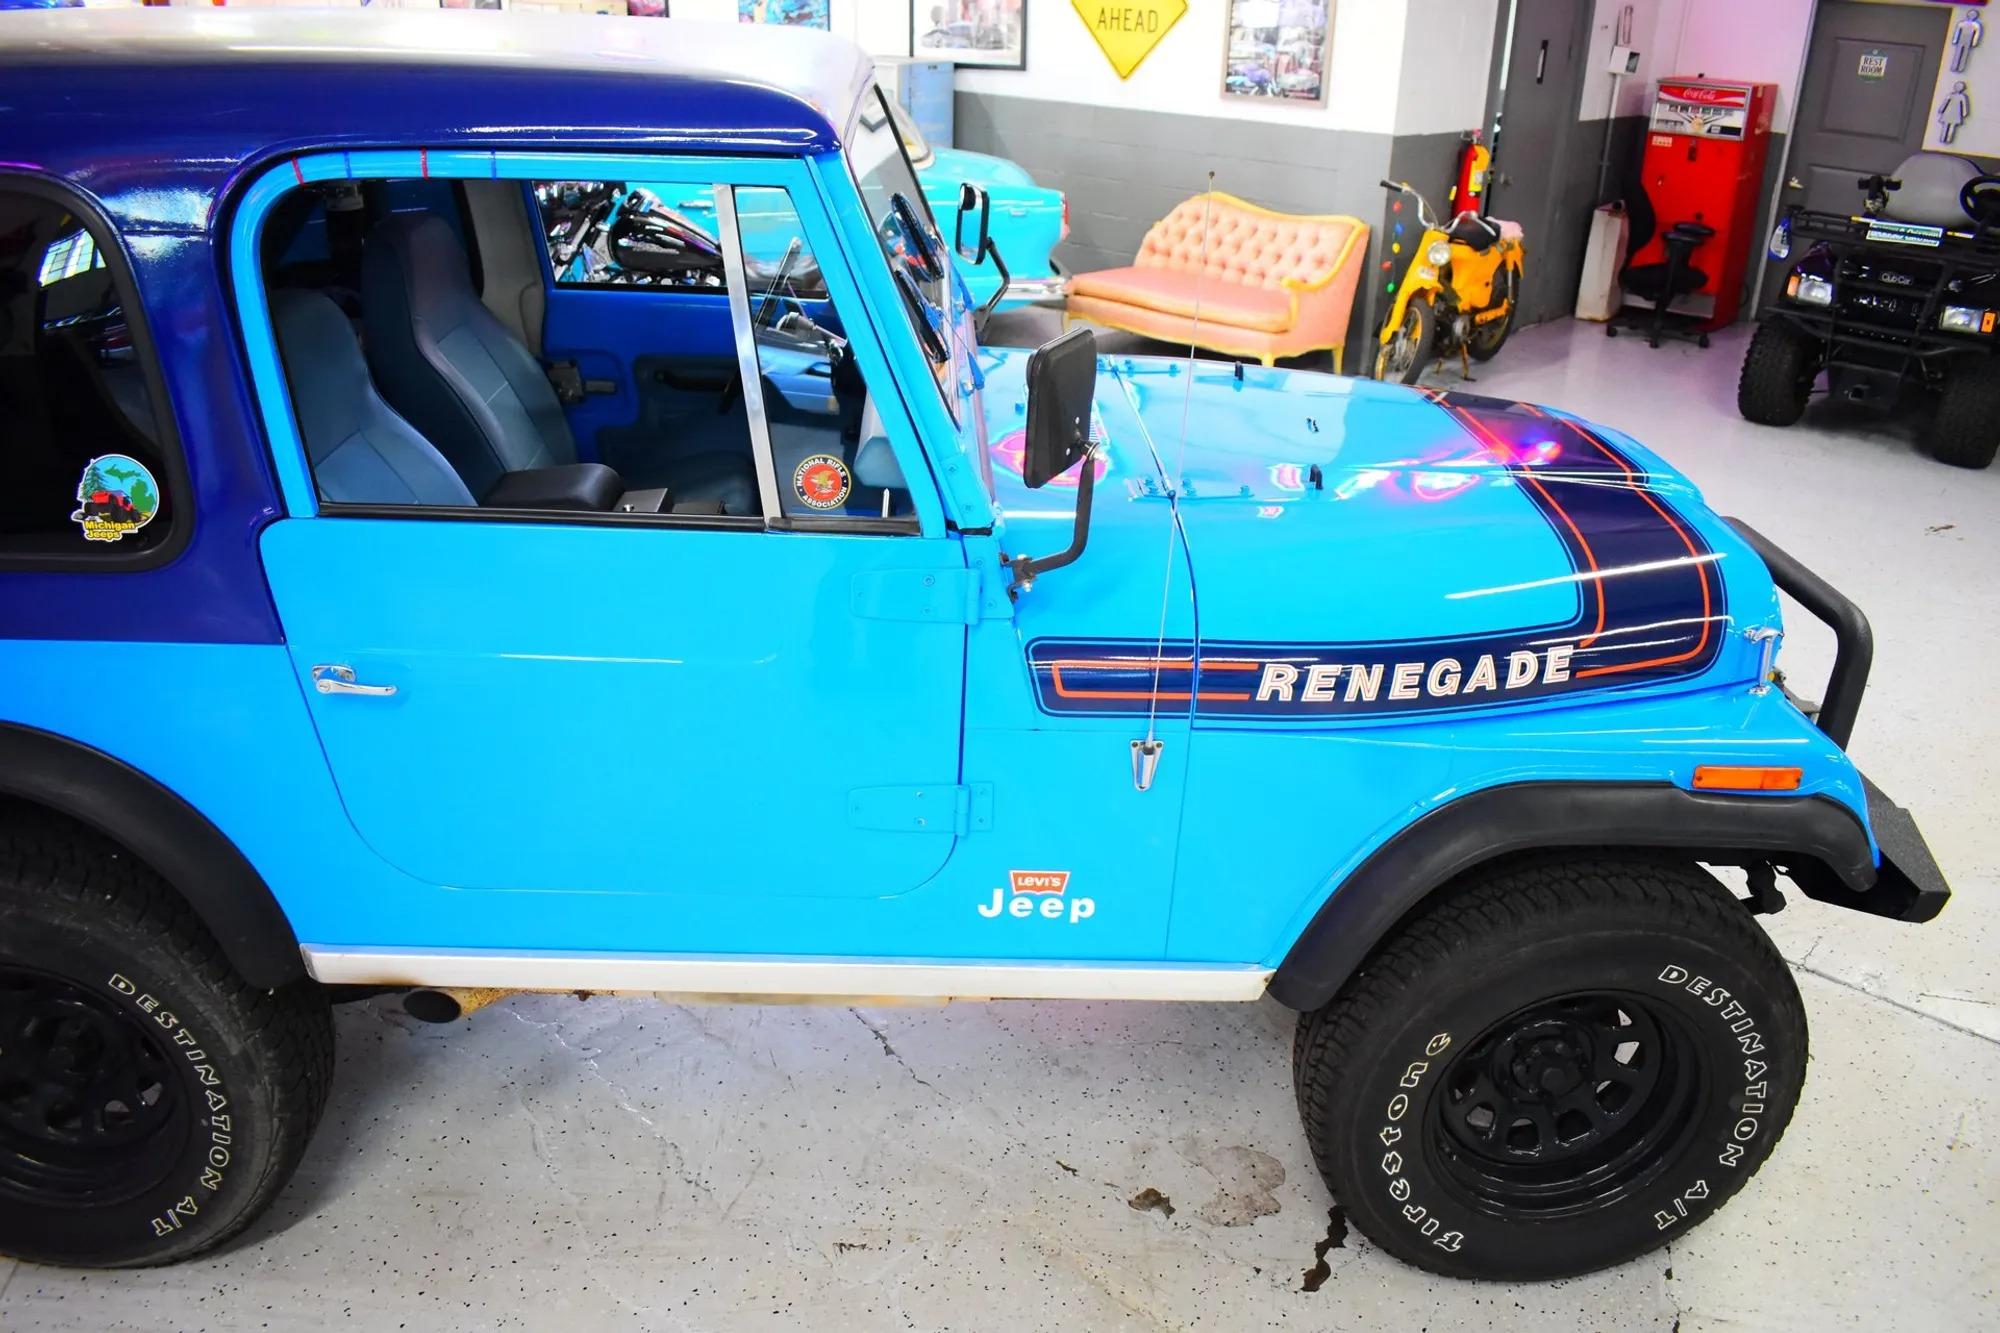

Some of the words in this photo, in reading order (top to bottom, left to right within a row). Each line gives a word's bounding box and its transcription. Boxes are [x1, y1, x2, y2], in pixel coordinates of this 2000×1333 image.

[1096, 7, 1158, 33] AHEAD
[1861, 65, 1882, 73] ROOM
[1864, 56, 1884, 66] REST
[797, 458, 825, 487] NATIONAL
[826, 459, 847, 477] RIFLE
[803, 487, 848, 507] ASSOCIATION
[84, 521, 136, 531] Michigan
[87, 530, 121, 540] Jeeps
[1256, 645, 1574, 702] RENEGADE
[977, 888, 1096, 923] Jeep
[108, 973, 232, 1190] DESTINATION
[1658, 964, 1768, 1168] DESTINATION
[1379, 1032, 1465, 1253] Firestone
[151, 1196, 198, 1237] A/T
[1654, 1180, 1710, 1230] A/T
